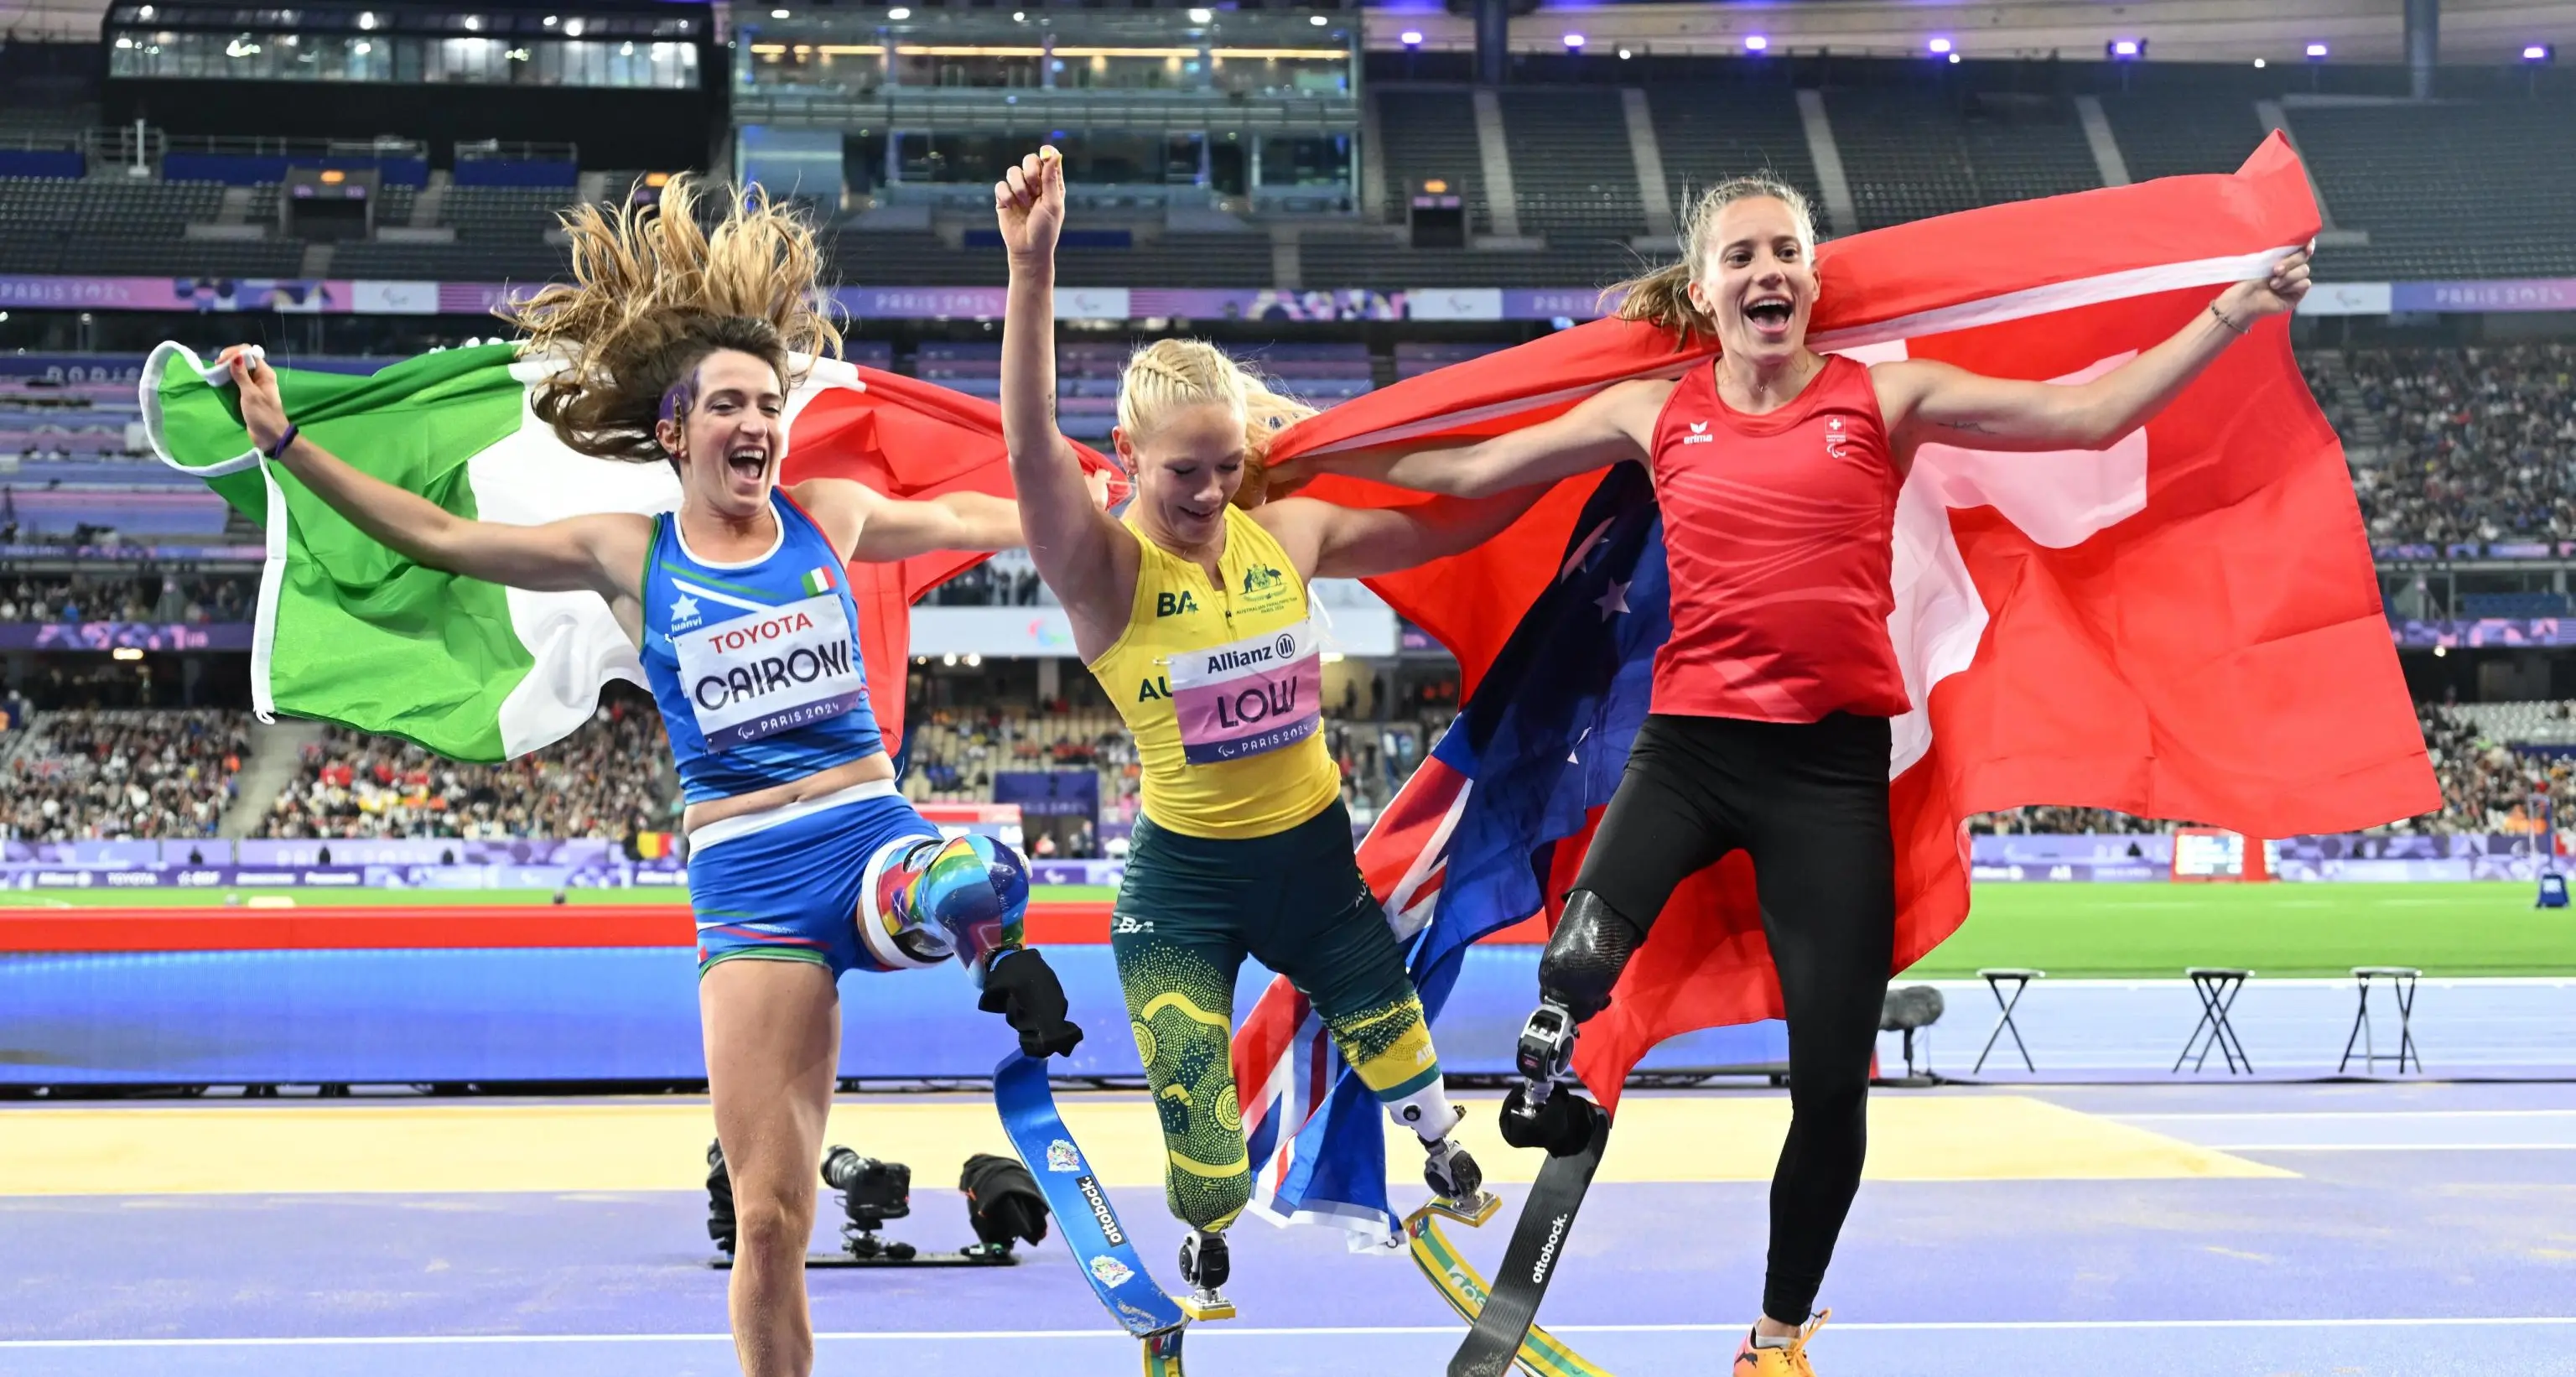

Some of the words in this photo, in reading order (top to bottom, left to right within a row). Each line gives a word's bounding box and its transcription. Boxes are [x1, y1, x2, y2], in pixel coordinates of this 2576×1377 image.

[1683, 433, 1713, 445] erima
[709, 612, 813, 653] TOYOTA
[695, 639, 850, 711] CAIRONI
[1208, 646, 1273, 673] Allianz
[761, 713, 801, 731] PARIS
[805, 702, 839, 720] 2024
[1218, 676, 1297, 728] LOW
[1242, 735, 1280, 753] PARIS
[1283, 724, 1310, 741] 2024
[1081, 1176, 1122, 1244] ottobock.
[1532, 1213, 1568, 1284] ottobock.
